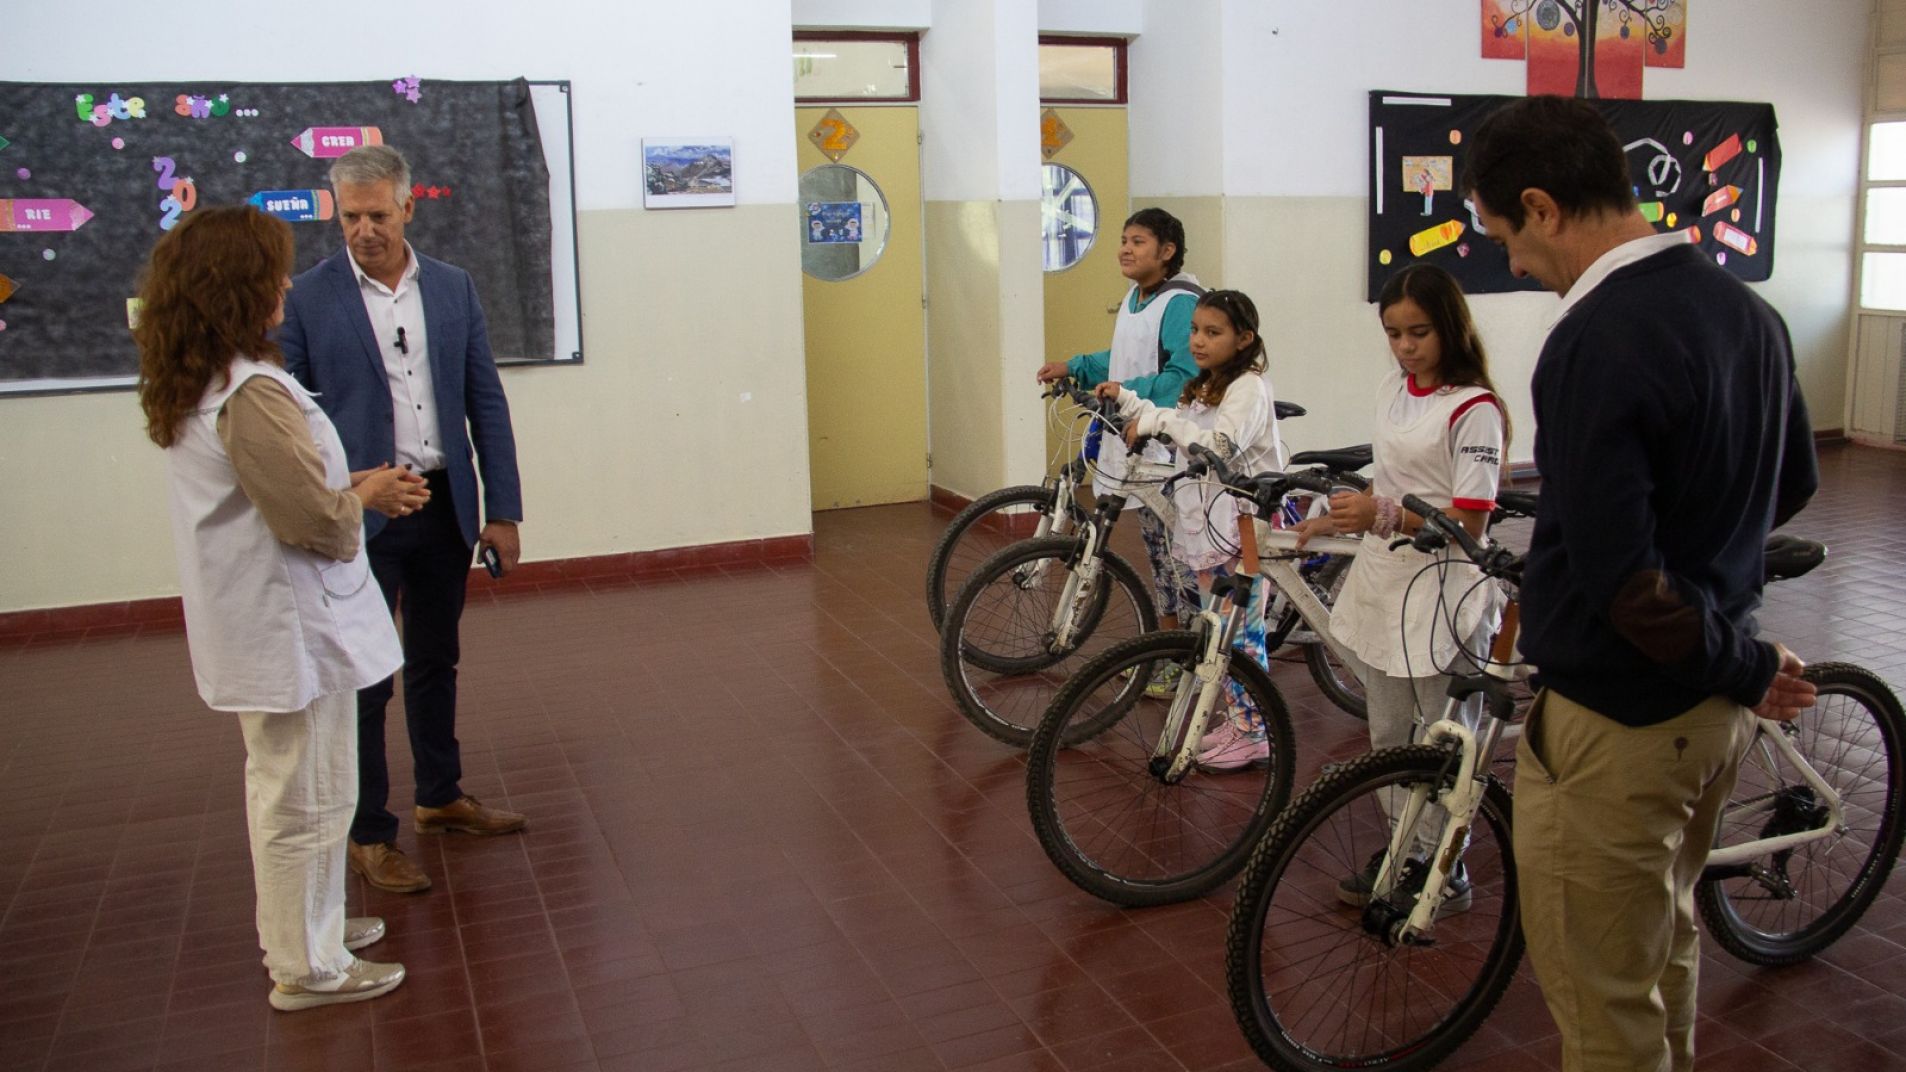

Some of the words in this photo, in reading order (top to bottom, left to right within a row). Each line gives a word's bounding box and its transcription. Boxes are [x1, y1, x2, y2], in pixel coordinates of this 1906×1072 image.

[76, 93, 146, 127] Este
[321, 135, 355, 147] CREA
[821, 118, 849, 151] 2
[266, 196, 309, 212] SUEÑA
[24, 208, 52, 220] RIE
[1460, 445, 1499, 456] ASSIST
